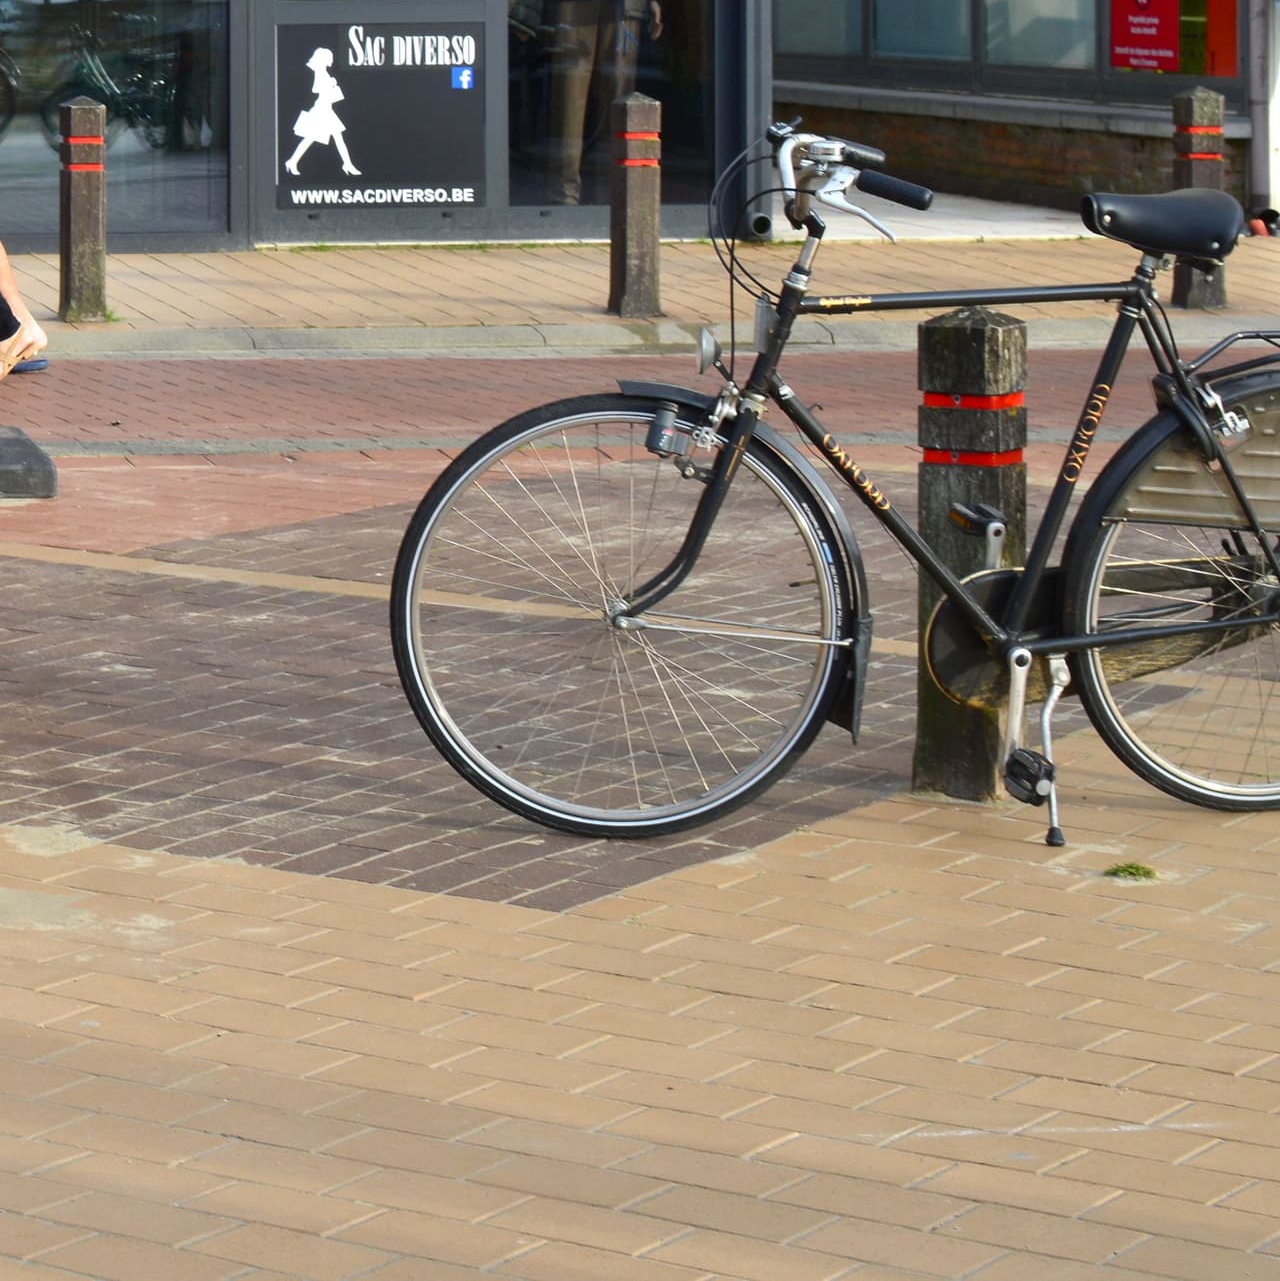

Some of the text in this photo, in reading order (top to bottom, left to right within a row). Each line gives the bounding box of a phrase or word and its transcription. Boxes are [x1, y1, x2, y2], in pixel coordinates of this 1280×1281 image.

[393, 35, 476, 66] DIVERSO
[290, 188, 475, 204] WWW.SACDIVERSO.BE
[1063, 383, 1112, 482] OXFORD
[823, 433, 890, 510] OXFORD
